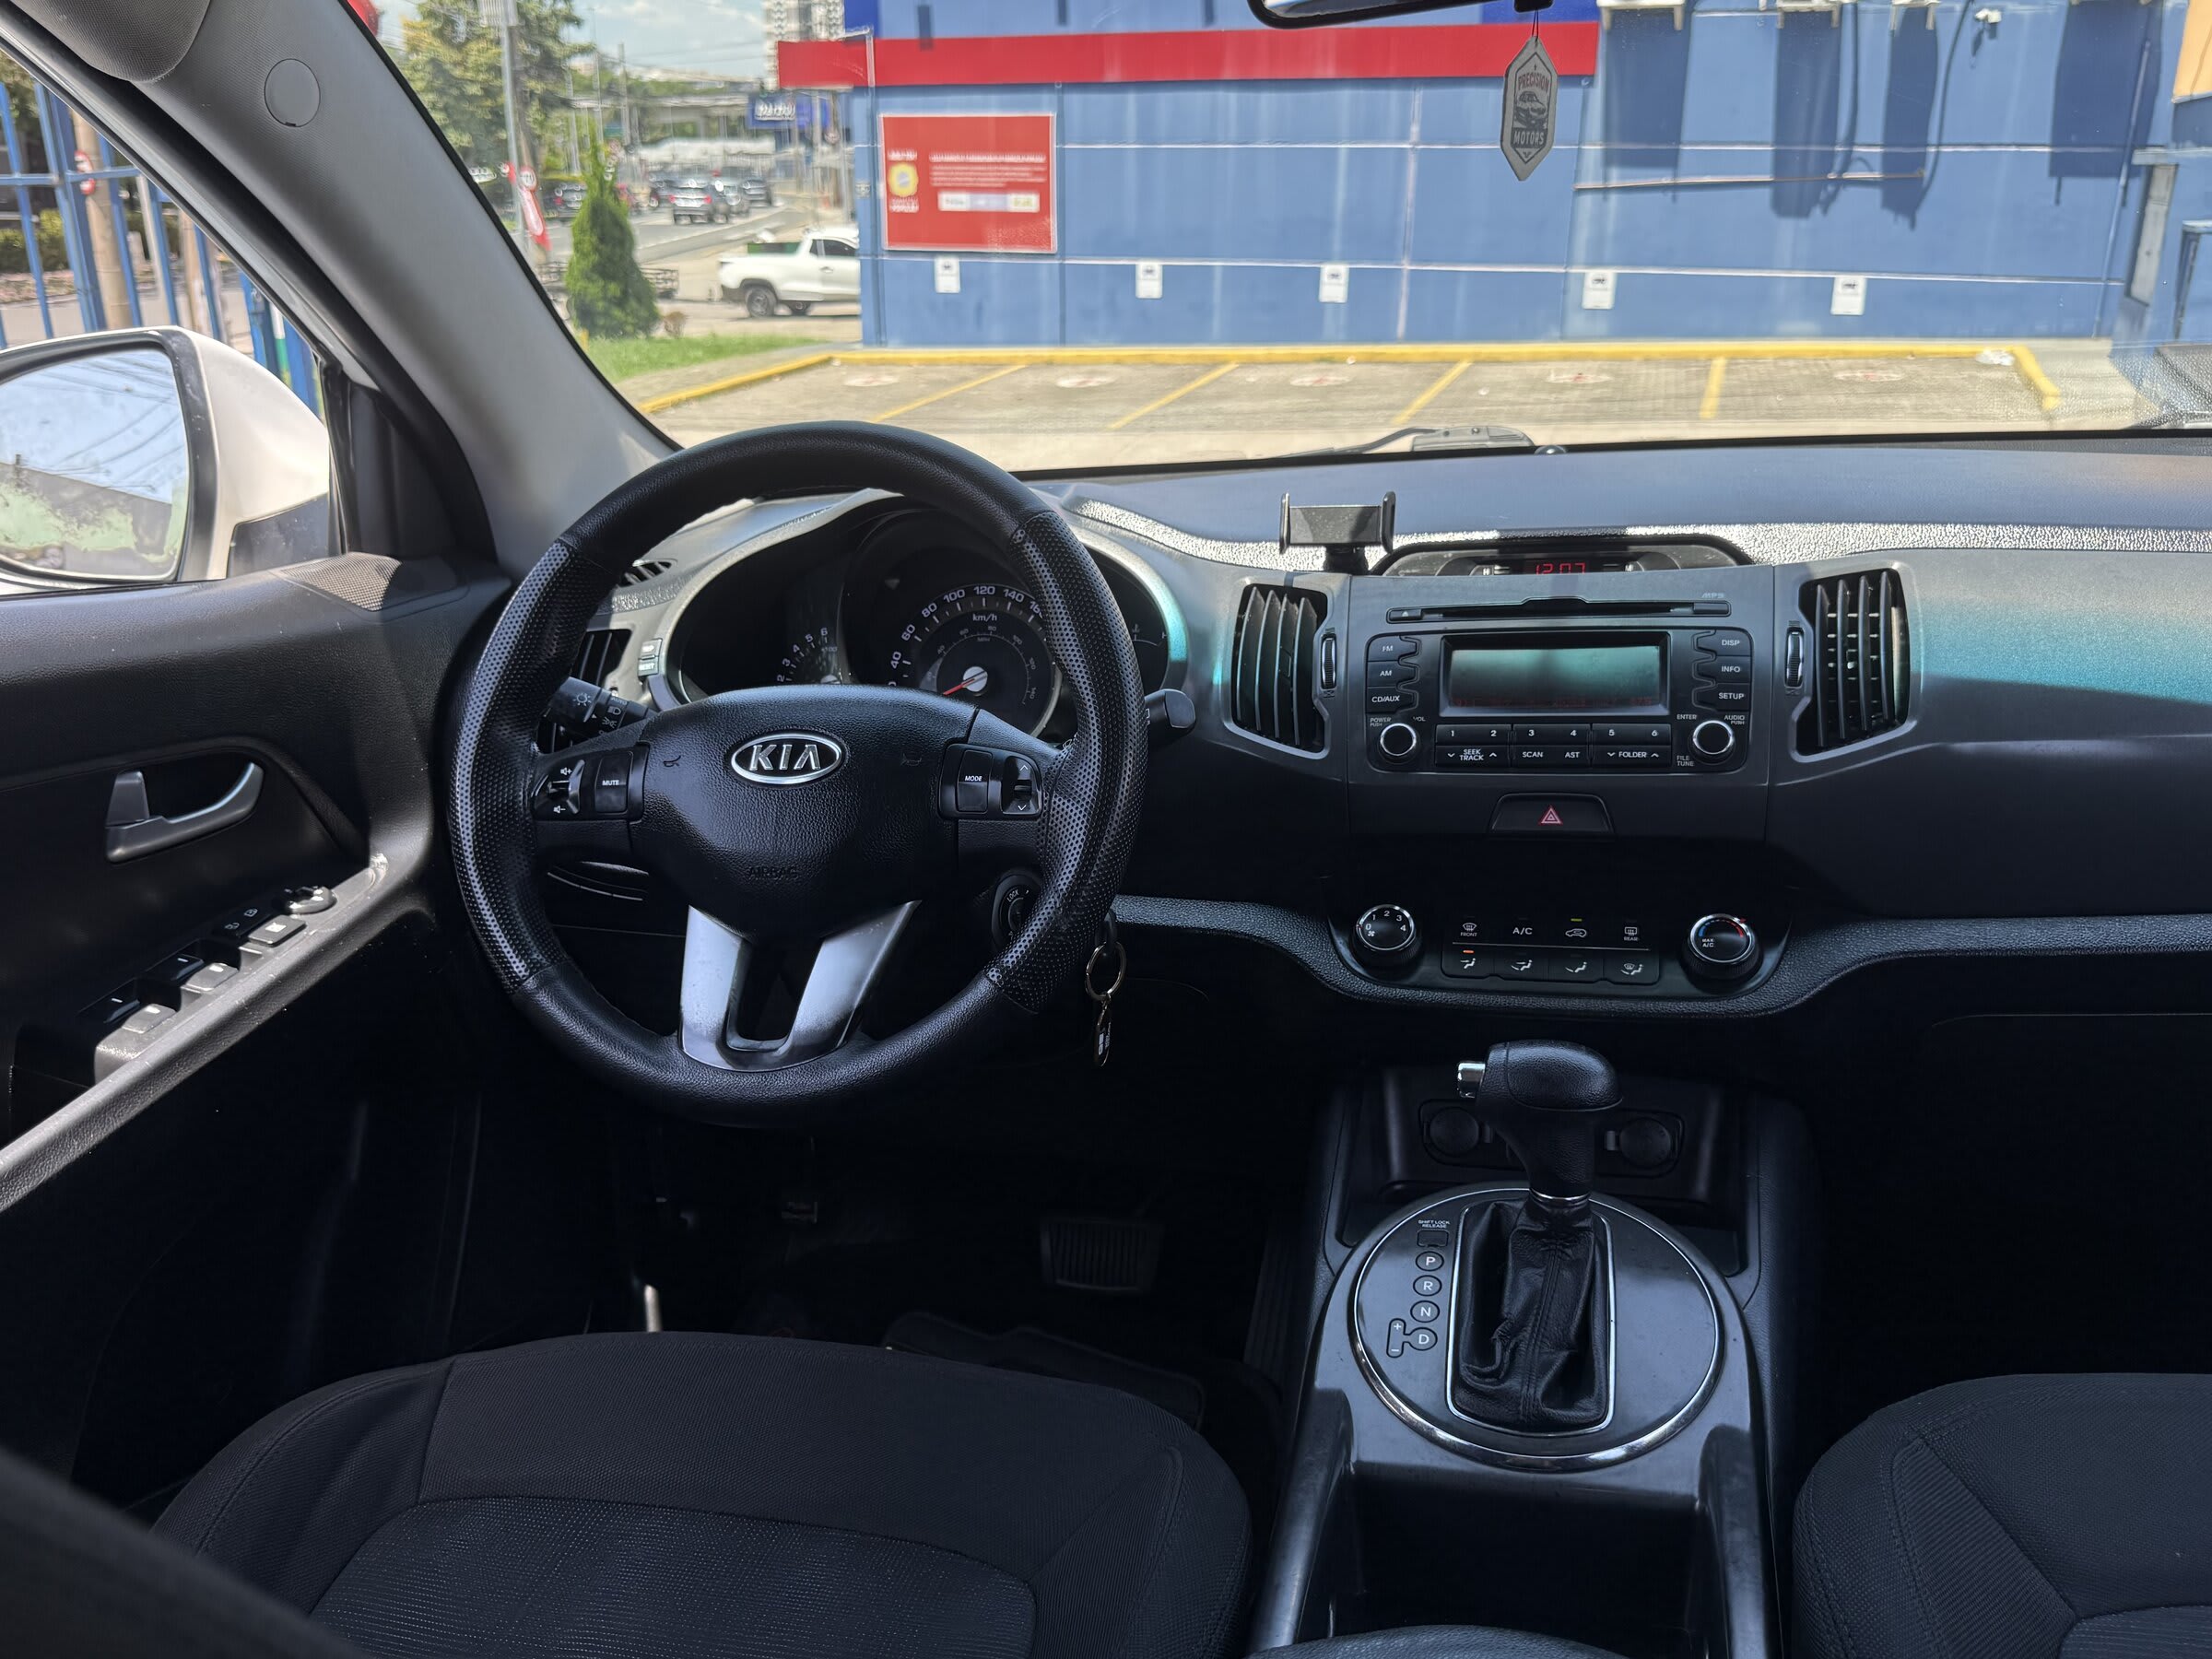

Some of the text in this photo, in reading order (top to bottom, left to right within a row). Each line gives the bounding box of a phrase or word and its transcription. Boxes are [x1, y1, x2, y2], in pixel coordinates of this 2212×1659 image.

[1518, 72, 1550, 93] PRECISION
[1512, 130, 1545, 145] MOTORS
[943, 589, 966, 603] 100
[973, 586, 995, 595] 120
[1003, 588, 1025, 603] 140
[922, 602, 937, 618] 80
[1030, 600, 1042, 618] 16
[972, 613, 997, 622] km/h
[805, 633, 813, 642] 5
[820, 628, 828, 636] 6
[901, 624, 915, 641] 60
[793, 644, 800, 653] 4
[782, 658, 791, 666] 3
[890, 651, 901, 669] 40
[777, 674, 784, 682] 2
[748, 744, 821, 771] KIA
[747, 865, 798, 879] AIRBAG
[1006, 888, 1019, 902] LOCK
[1426, 1256, 1436, 1266] P
[1423, 1281, 1433, 1291] R
[1420, 1307, 1431, 1317] N
[1418, 1334, 1430, 1345] D
